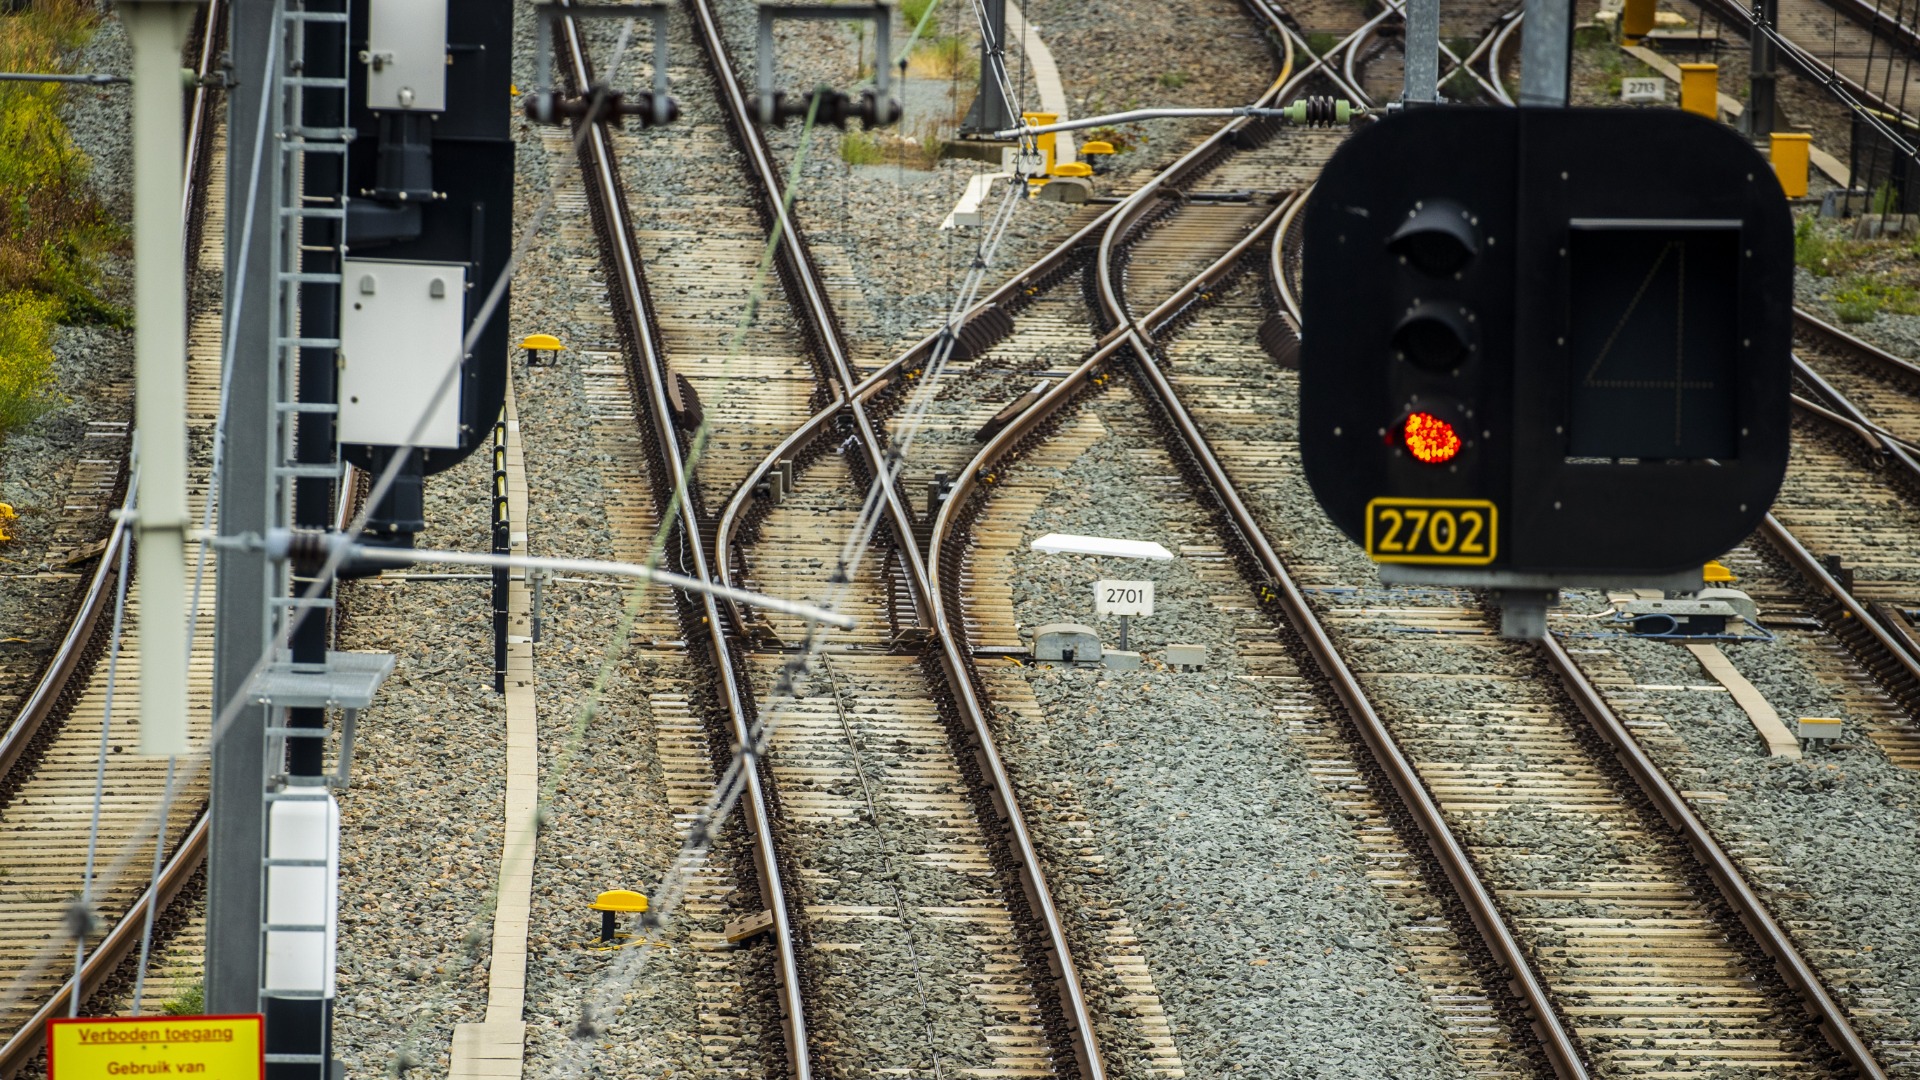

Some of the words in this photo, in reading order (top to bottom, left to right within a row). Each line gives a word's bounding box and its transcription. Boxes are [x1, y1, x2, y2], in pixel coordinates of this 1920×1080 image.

[1379, 508, 1484, 553] 2702
[1106, 588, 1143, 603] 2701
[78, 1028, 160, 1043] Verboden
[165, 1027, 233, 1041] toegang
[107, 1061, 171, 1075] Gebruik
[176, 1062, 205, 1073] van
